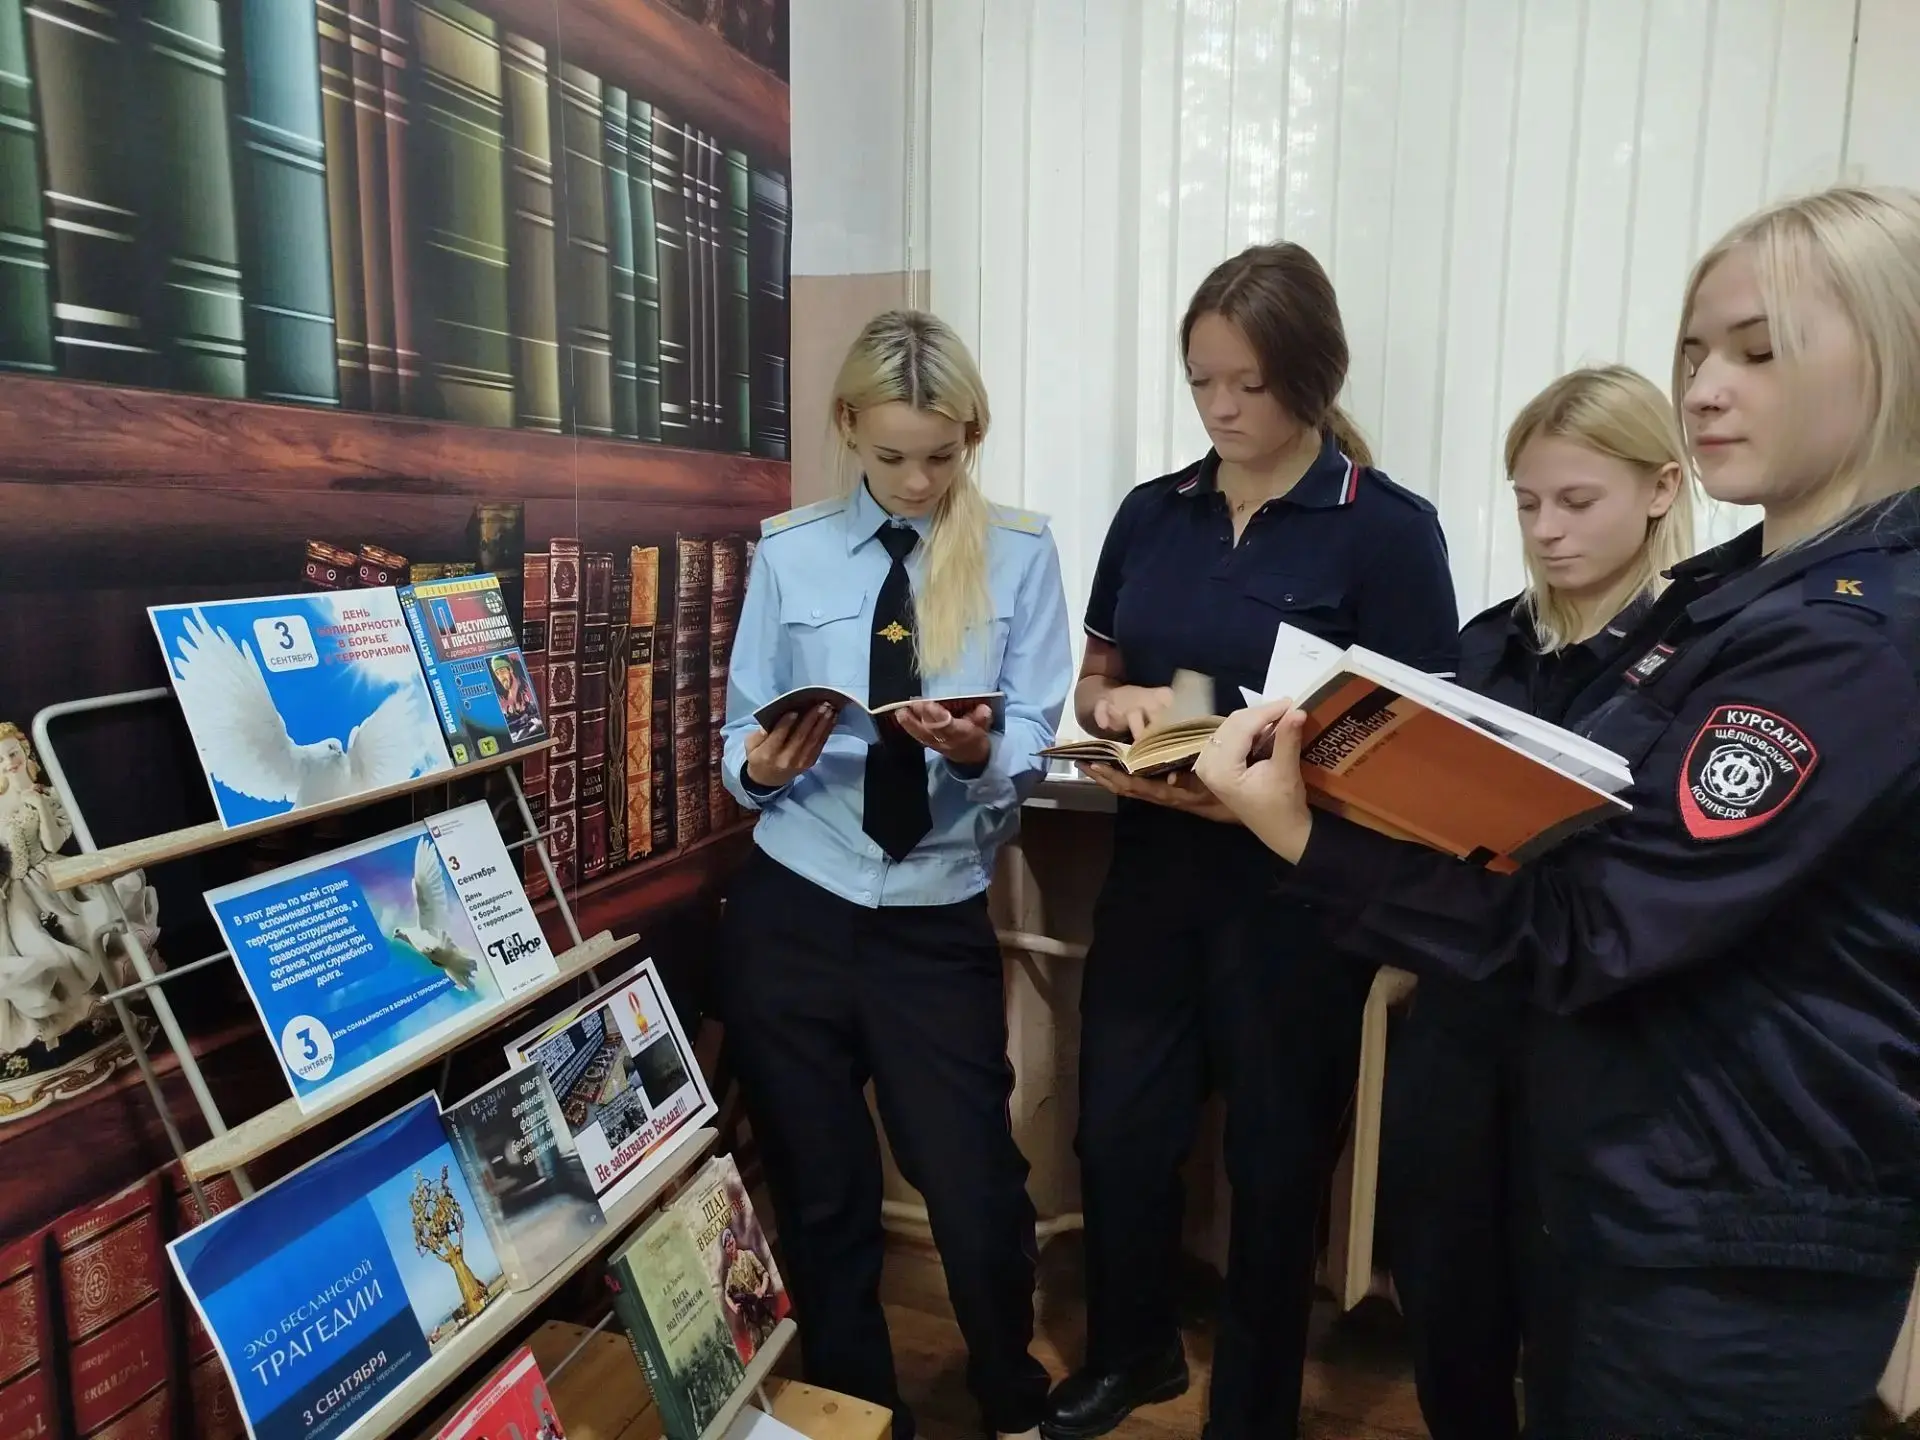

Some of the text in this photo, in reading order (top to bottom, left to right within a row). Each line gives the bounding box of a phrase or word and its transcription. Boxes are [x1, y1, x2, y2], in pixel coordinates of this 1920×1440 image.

[1835, 579, 1864, 596] К
[342, 608, 371, 621] ДЕНЬ
[274, 622, 294, 650] 3
[338, 633, 389, 649] В БОРЬБЕ
[441, 636, 450, 649] И
[451, 626, 513, 649] ПРЕСТУПЛЕНИЯ
[270, 652, 314, 666] СЕНТЯБРЯ
[335, 643, 412, 663] ТЕРРОРИЗМОМ
[432, 678, 457, 735] ПРЕСТУПНИКИ
[1305, 715, 1362, 767] ВОЕННЫЕ
[1322, 708, 1398, 770] ПРЕСТУПЛЕНИЯ
[1727, 710, 1808, 754] КУРСАНТ
[1715, 728, 1795, 773] ЩЁЛКОВСКИЙ
[1690, 784, 1748, 819] КОЛЛЕДЖ
[448, 856, 460, 871] 3
[457, 865, 497, 886] сентября
[233, 879, 349, 926] В этот день по всей стране
[258, 895, 339, 930] вспоминают жертв
[464, 891, 482, 904] День
[469, 889, 513, 912] солидарности
[478, 904, 502, 920] борьбе
[245, 900, 358, 948] террористических актов, а
[268, 916, 349, 953] также сотрудников
[483, 906, 524, 930] терроризмом
[269, 924, 358, 966] правоохранительных
[270, 933, 367, 979] органов, погибших при
[271, 942, 374, 991] выполнении служебного
[316, 969, 344, 988] долга.
[332, 1029, 347, 1040] ДЕНЬ
[347, 1006, 390, 1032] СОЛИДАРНОСТИ
[389, 1003, 394, 1011] В
[296, 1027, 319, 1060] 3
[299, 1053, 333, 1075] СЕНТЯБРЯ
[520, 1075, 540, 1095] ольга
[511, 1090, 547, 1118] алленова
[511, 1130, 538, 1154] беслан
[540, 1127, 545, 1136] и
[595, 1096, 688, 1184] Не забывайте Беслан!!!
[702, 1188, 727, 1224] ШАГ
[697, 1236, 704, 1252] В
[243, 1258, 373, 1360] ЭХО БЕСЛАНСКОЙ
[251, 1278, 384, 1387] ТРАГЕДИИ
[303, 1350, 387, 1427] 3 СЕНТЯБРЯ
